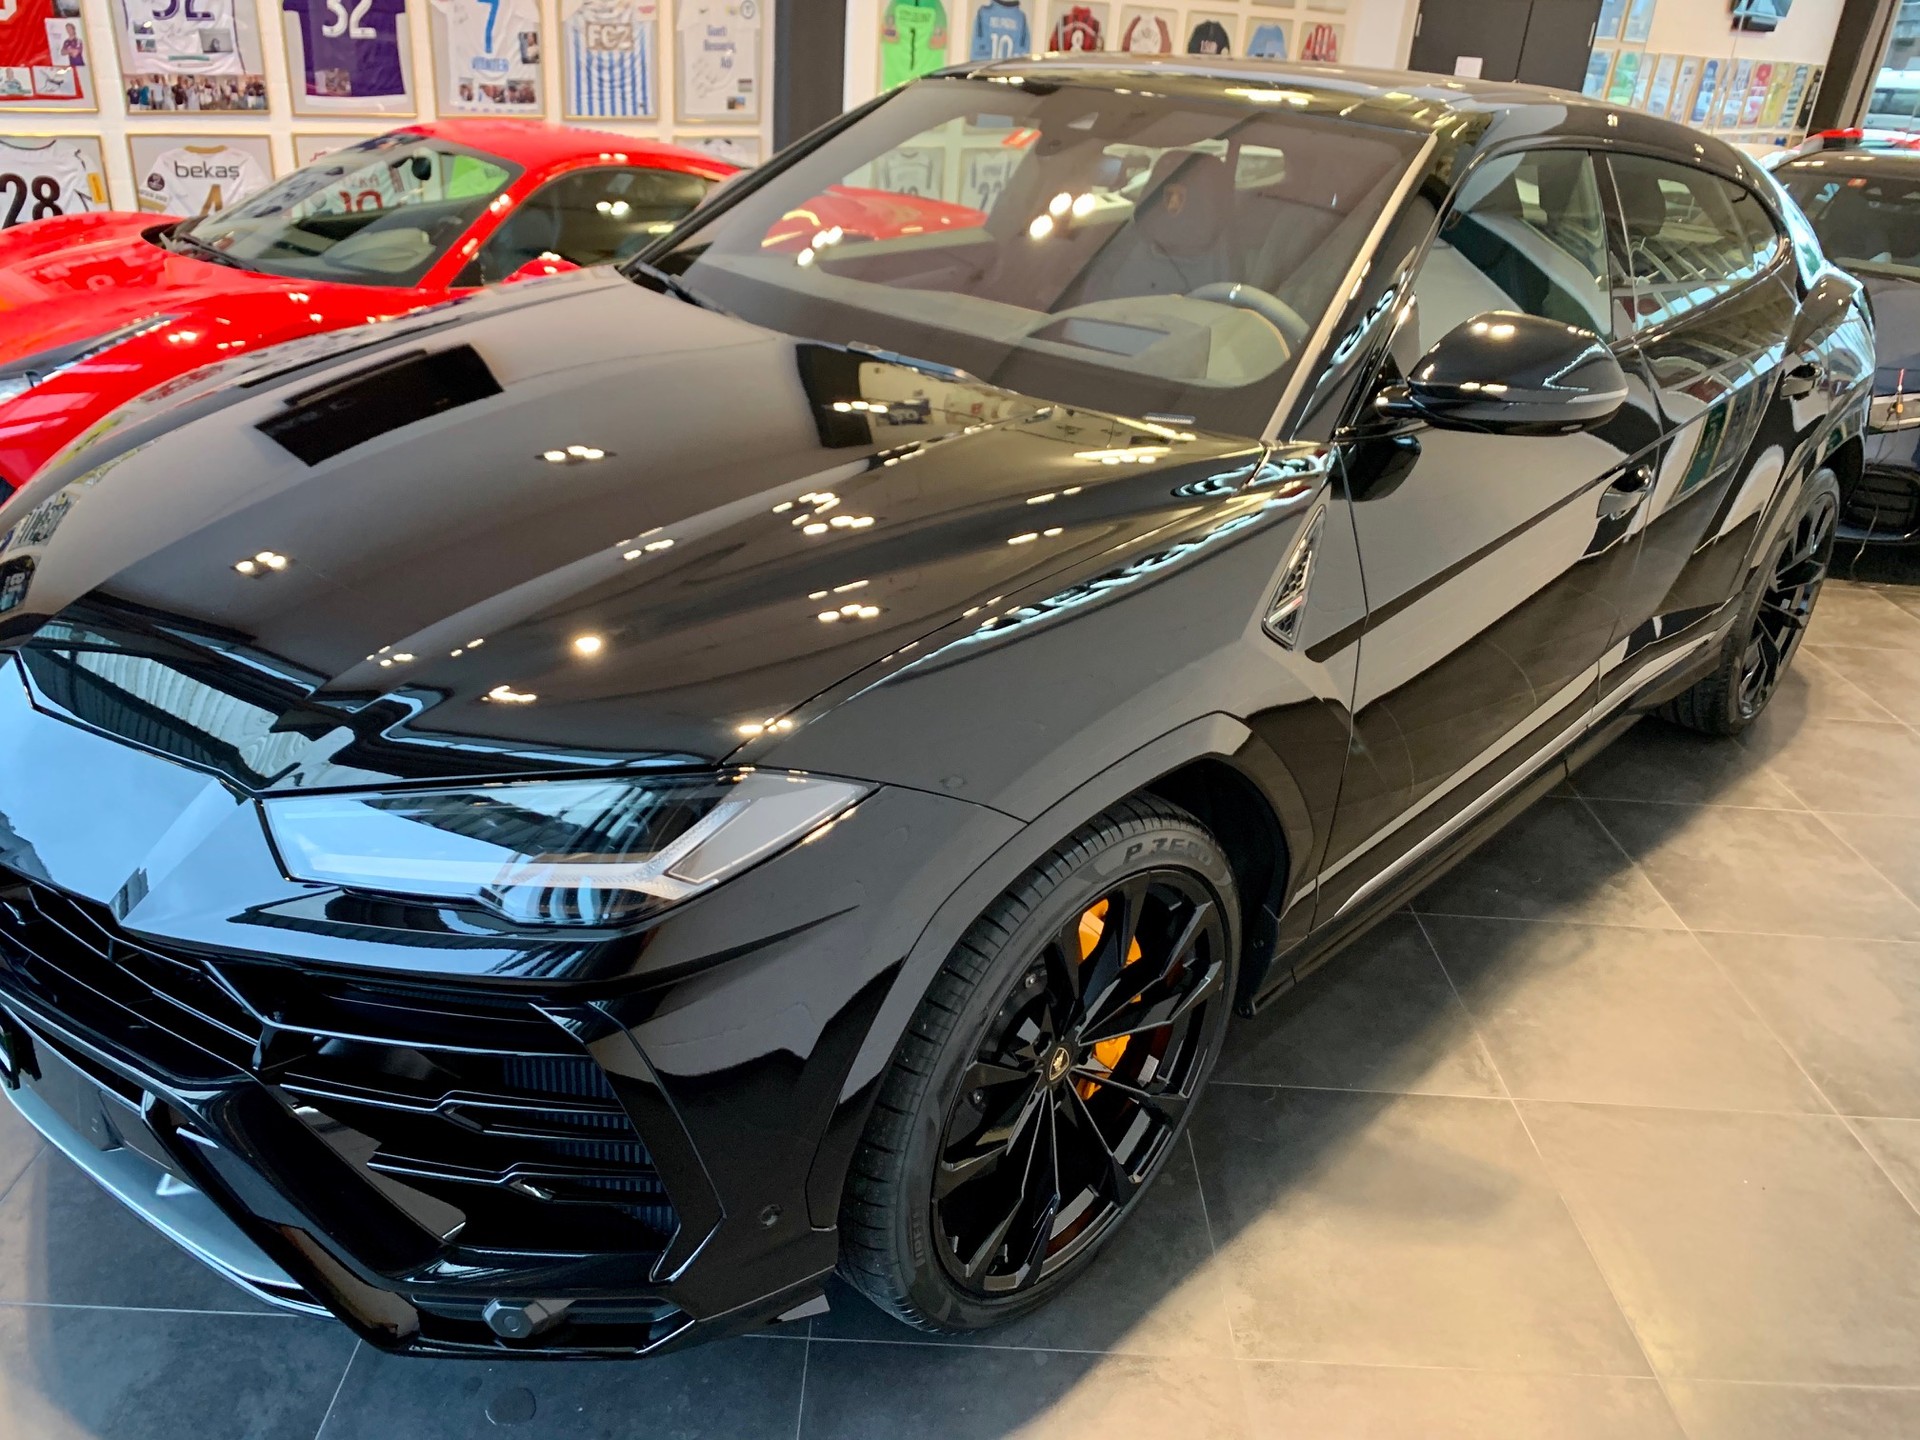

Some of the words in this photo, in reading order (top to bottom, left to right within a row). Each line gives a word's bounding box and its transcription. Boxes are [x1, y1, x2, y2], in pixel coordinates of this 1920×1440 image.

[587, 24, 632, 48] FCZ
[174, 160, 240, 181] bekaş
[0, 173, 63, 230] 28
